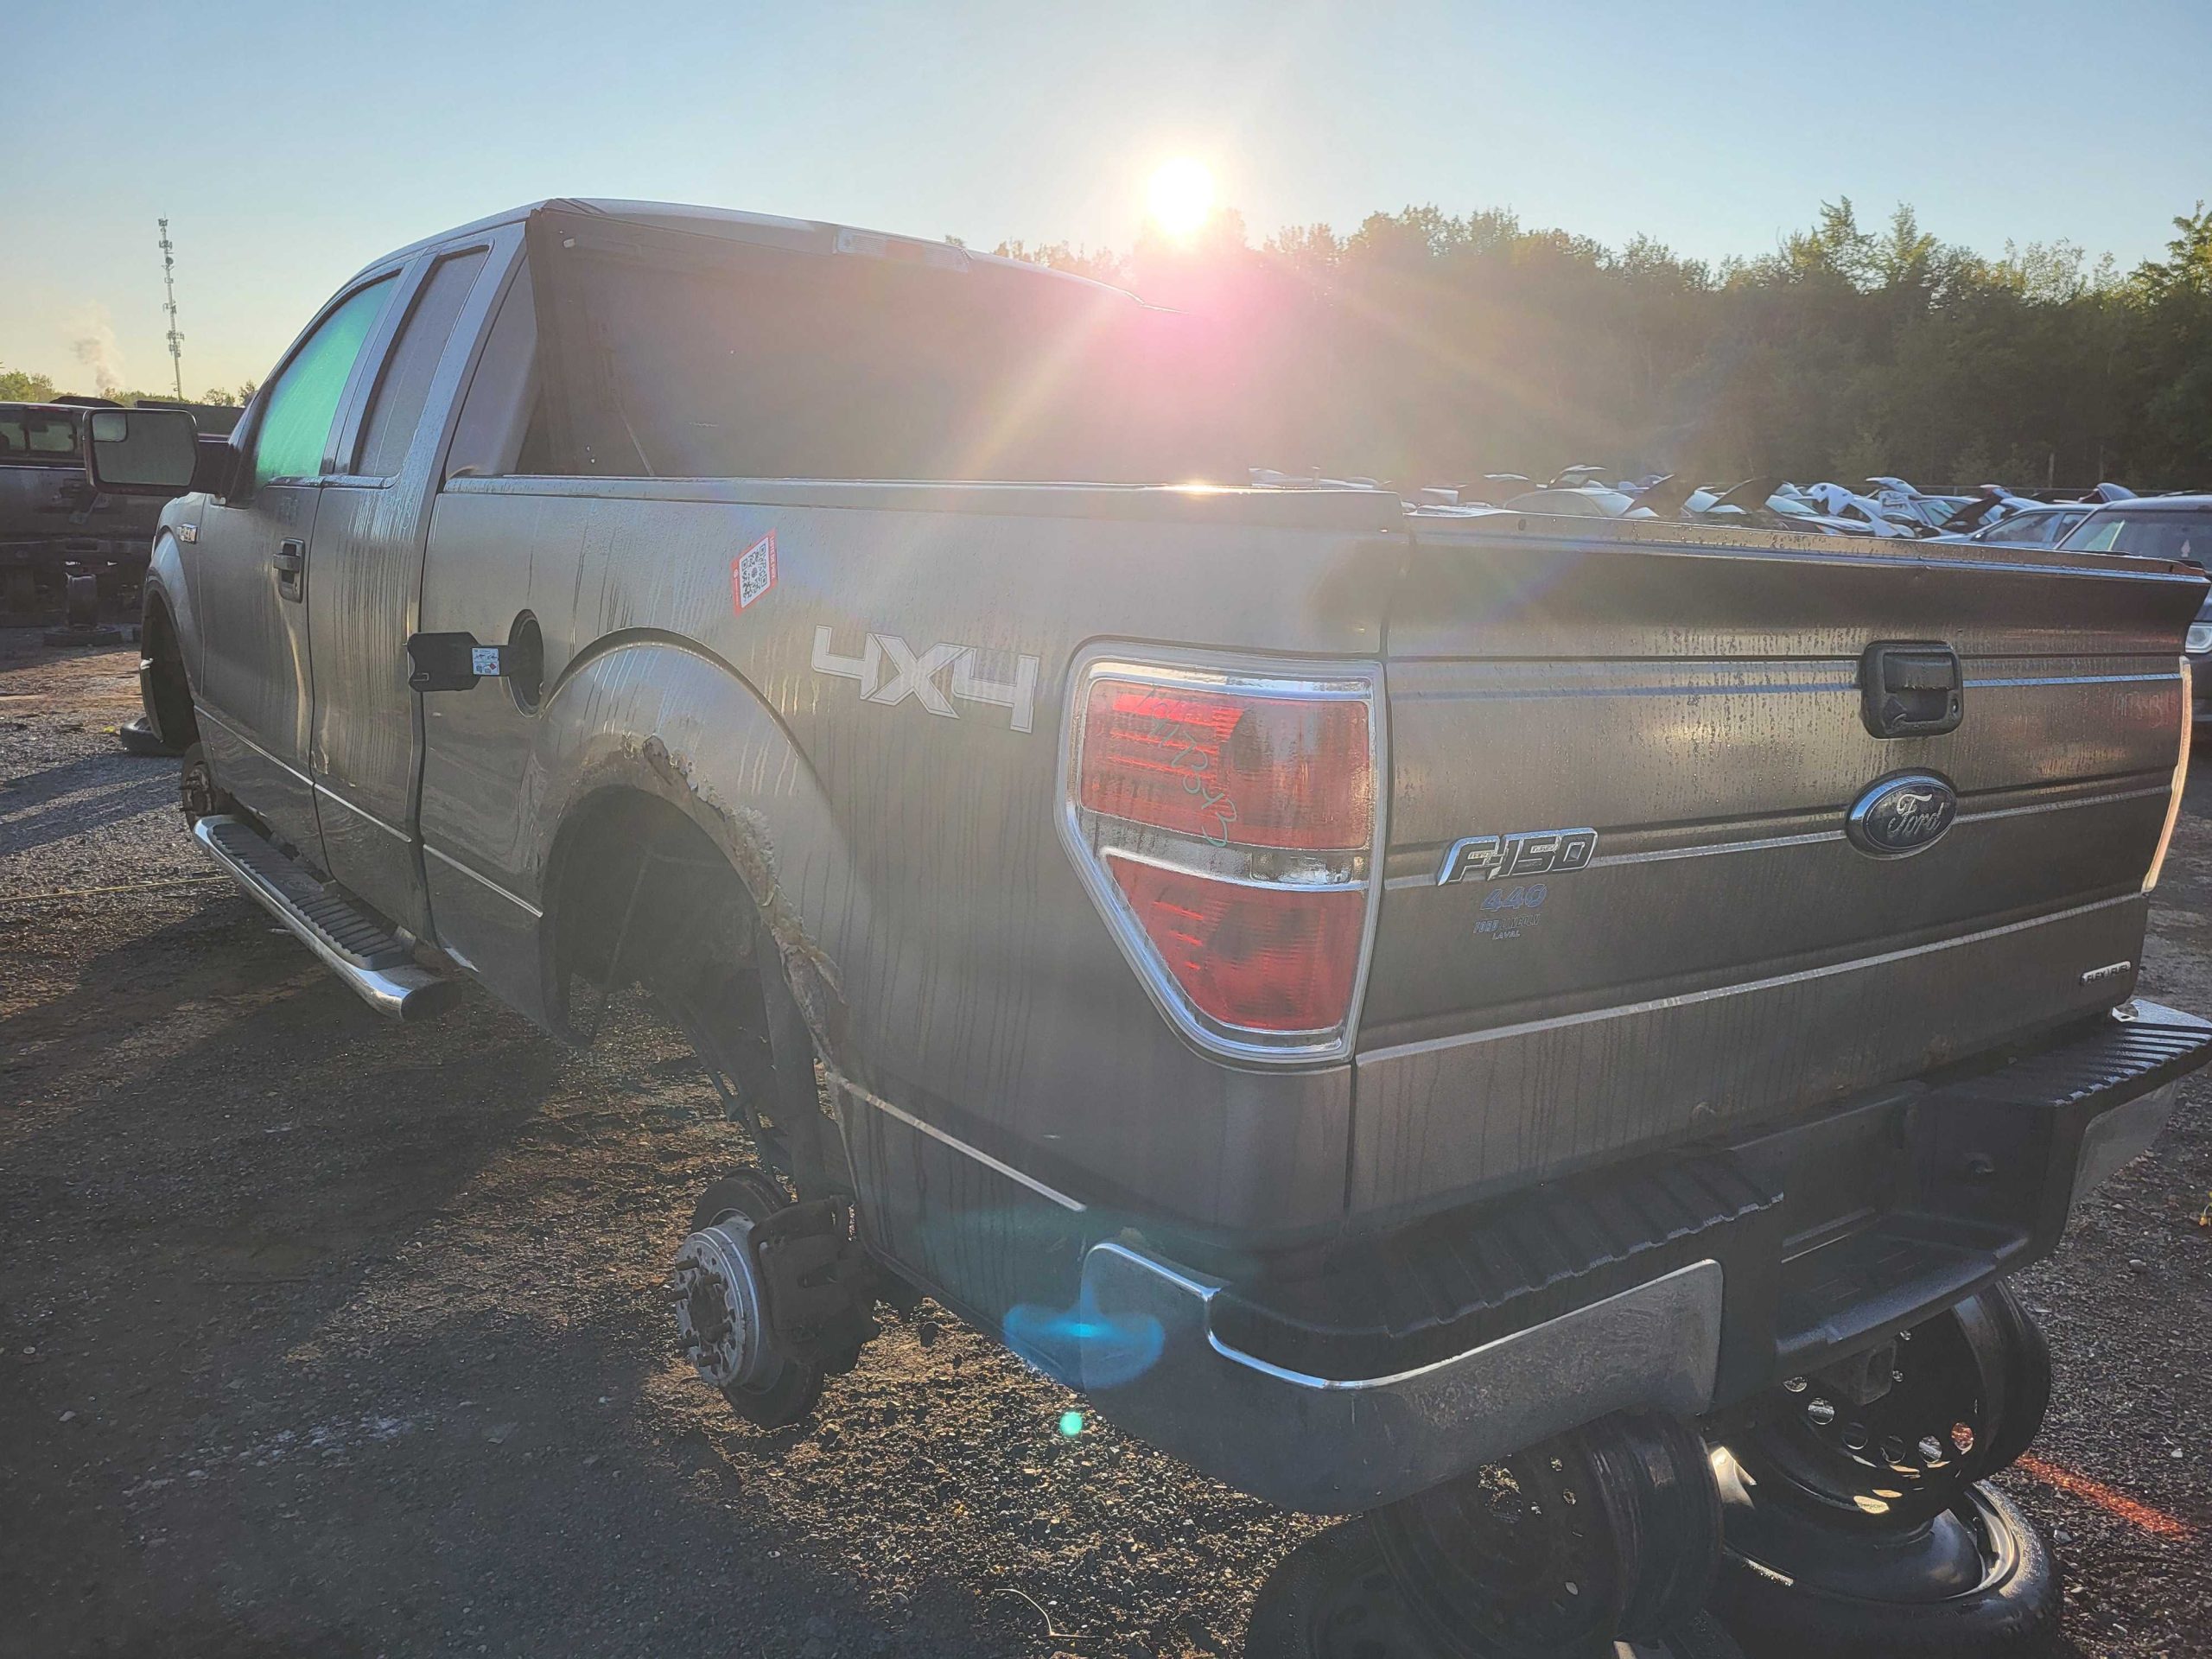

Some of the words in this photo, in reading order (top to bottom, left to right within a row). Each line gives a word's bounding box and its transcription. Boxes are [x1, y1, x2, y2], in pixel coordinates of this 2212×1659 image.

[1887, 793, 1945, 836] Ford
[1438, 827, 1599, 887] F-150
[1479, 883, 1548, 912] 440
[1472, 919, 1499, 934] FORD
[1491, 930, 1521, 941] LAVAL
